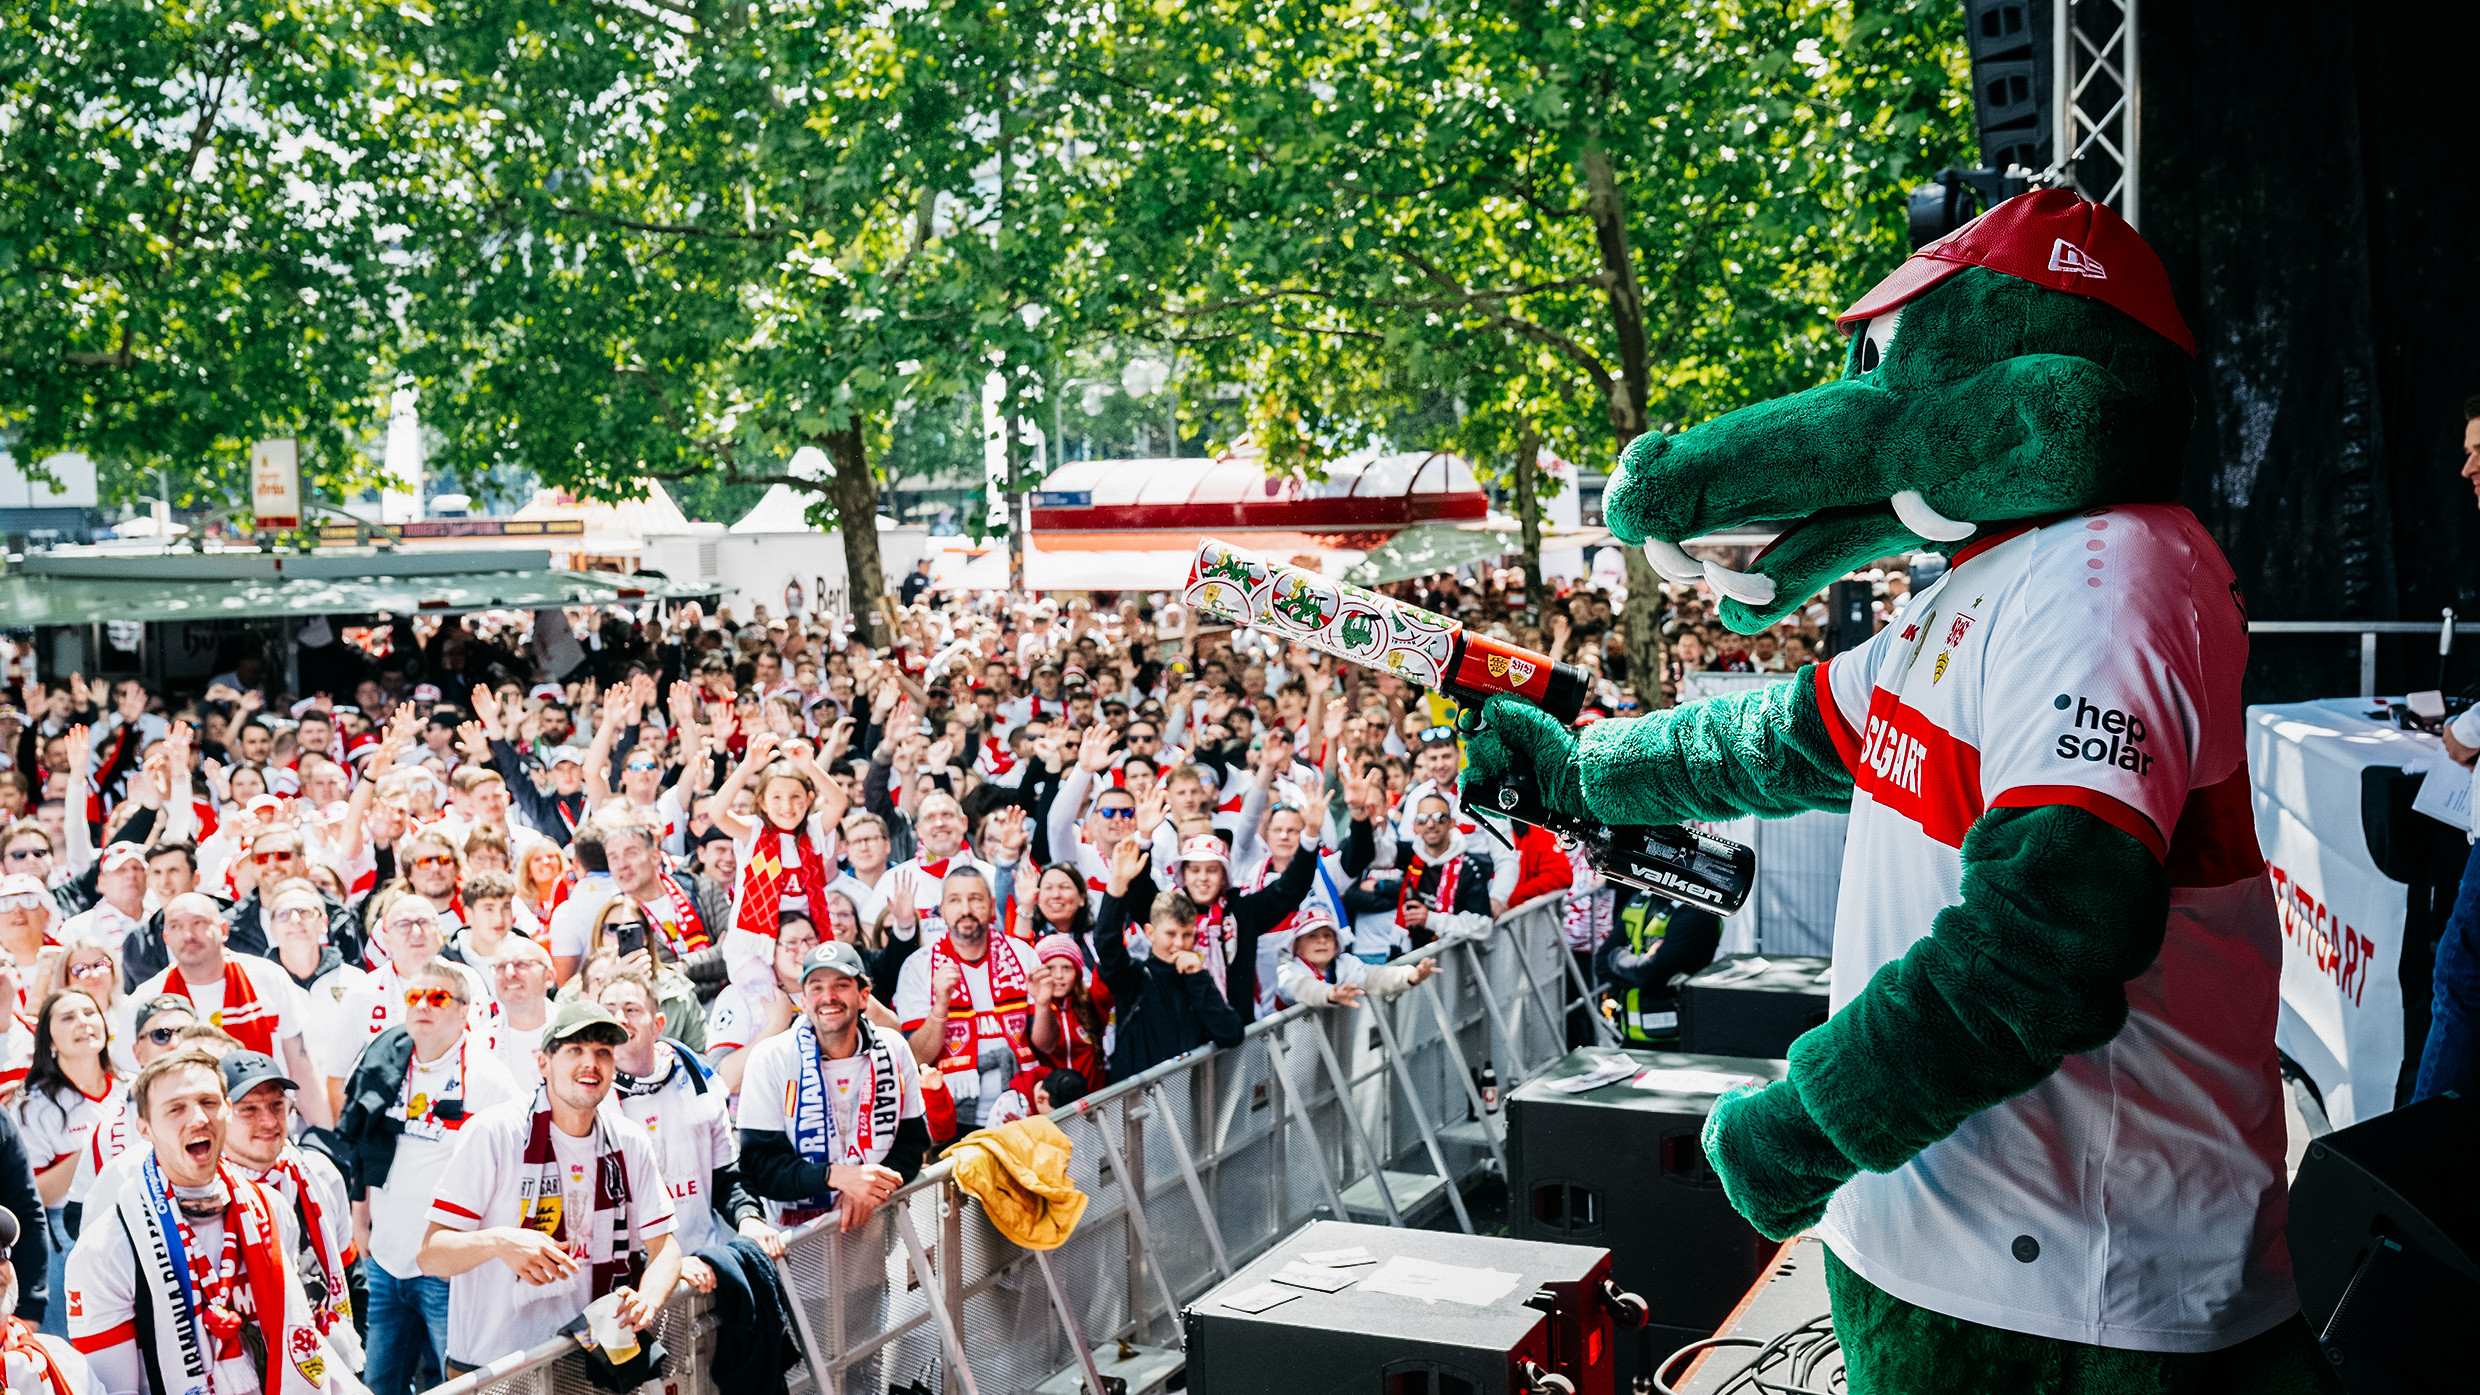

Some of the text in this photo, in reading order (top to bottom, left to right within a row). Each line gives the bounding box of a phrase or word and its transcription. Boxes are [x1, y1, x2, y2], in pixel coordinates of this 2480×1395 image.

[2075, 697, 2146, 744] hep
[2056, 730, 2154, 777] solar
[858, 1110, 870, 1138] 2024
[168, 1290, 204, 1378] ARMINIA
